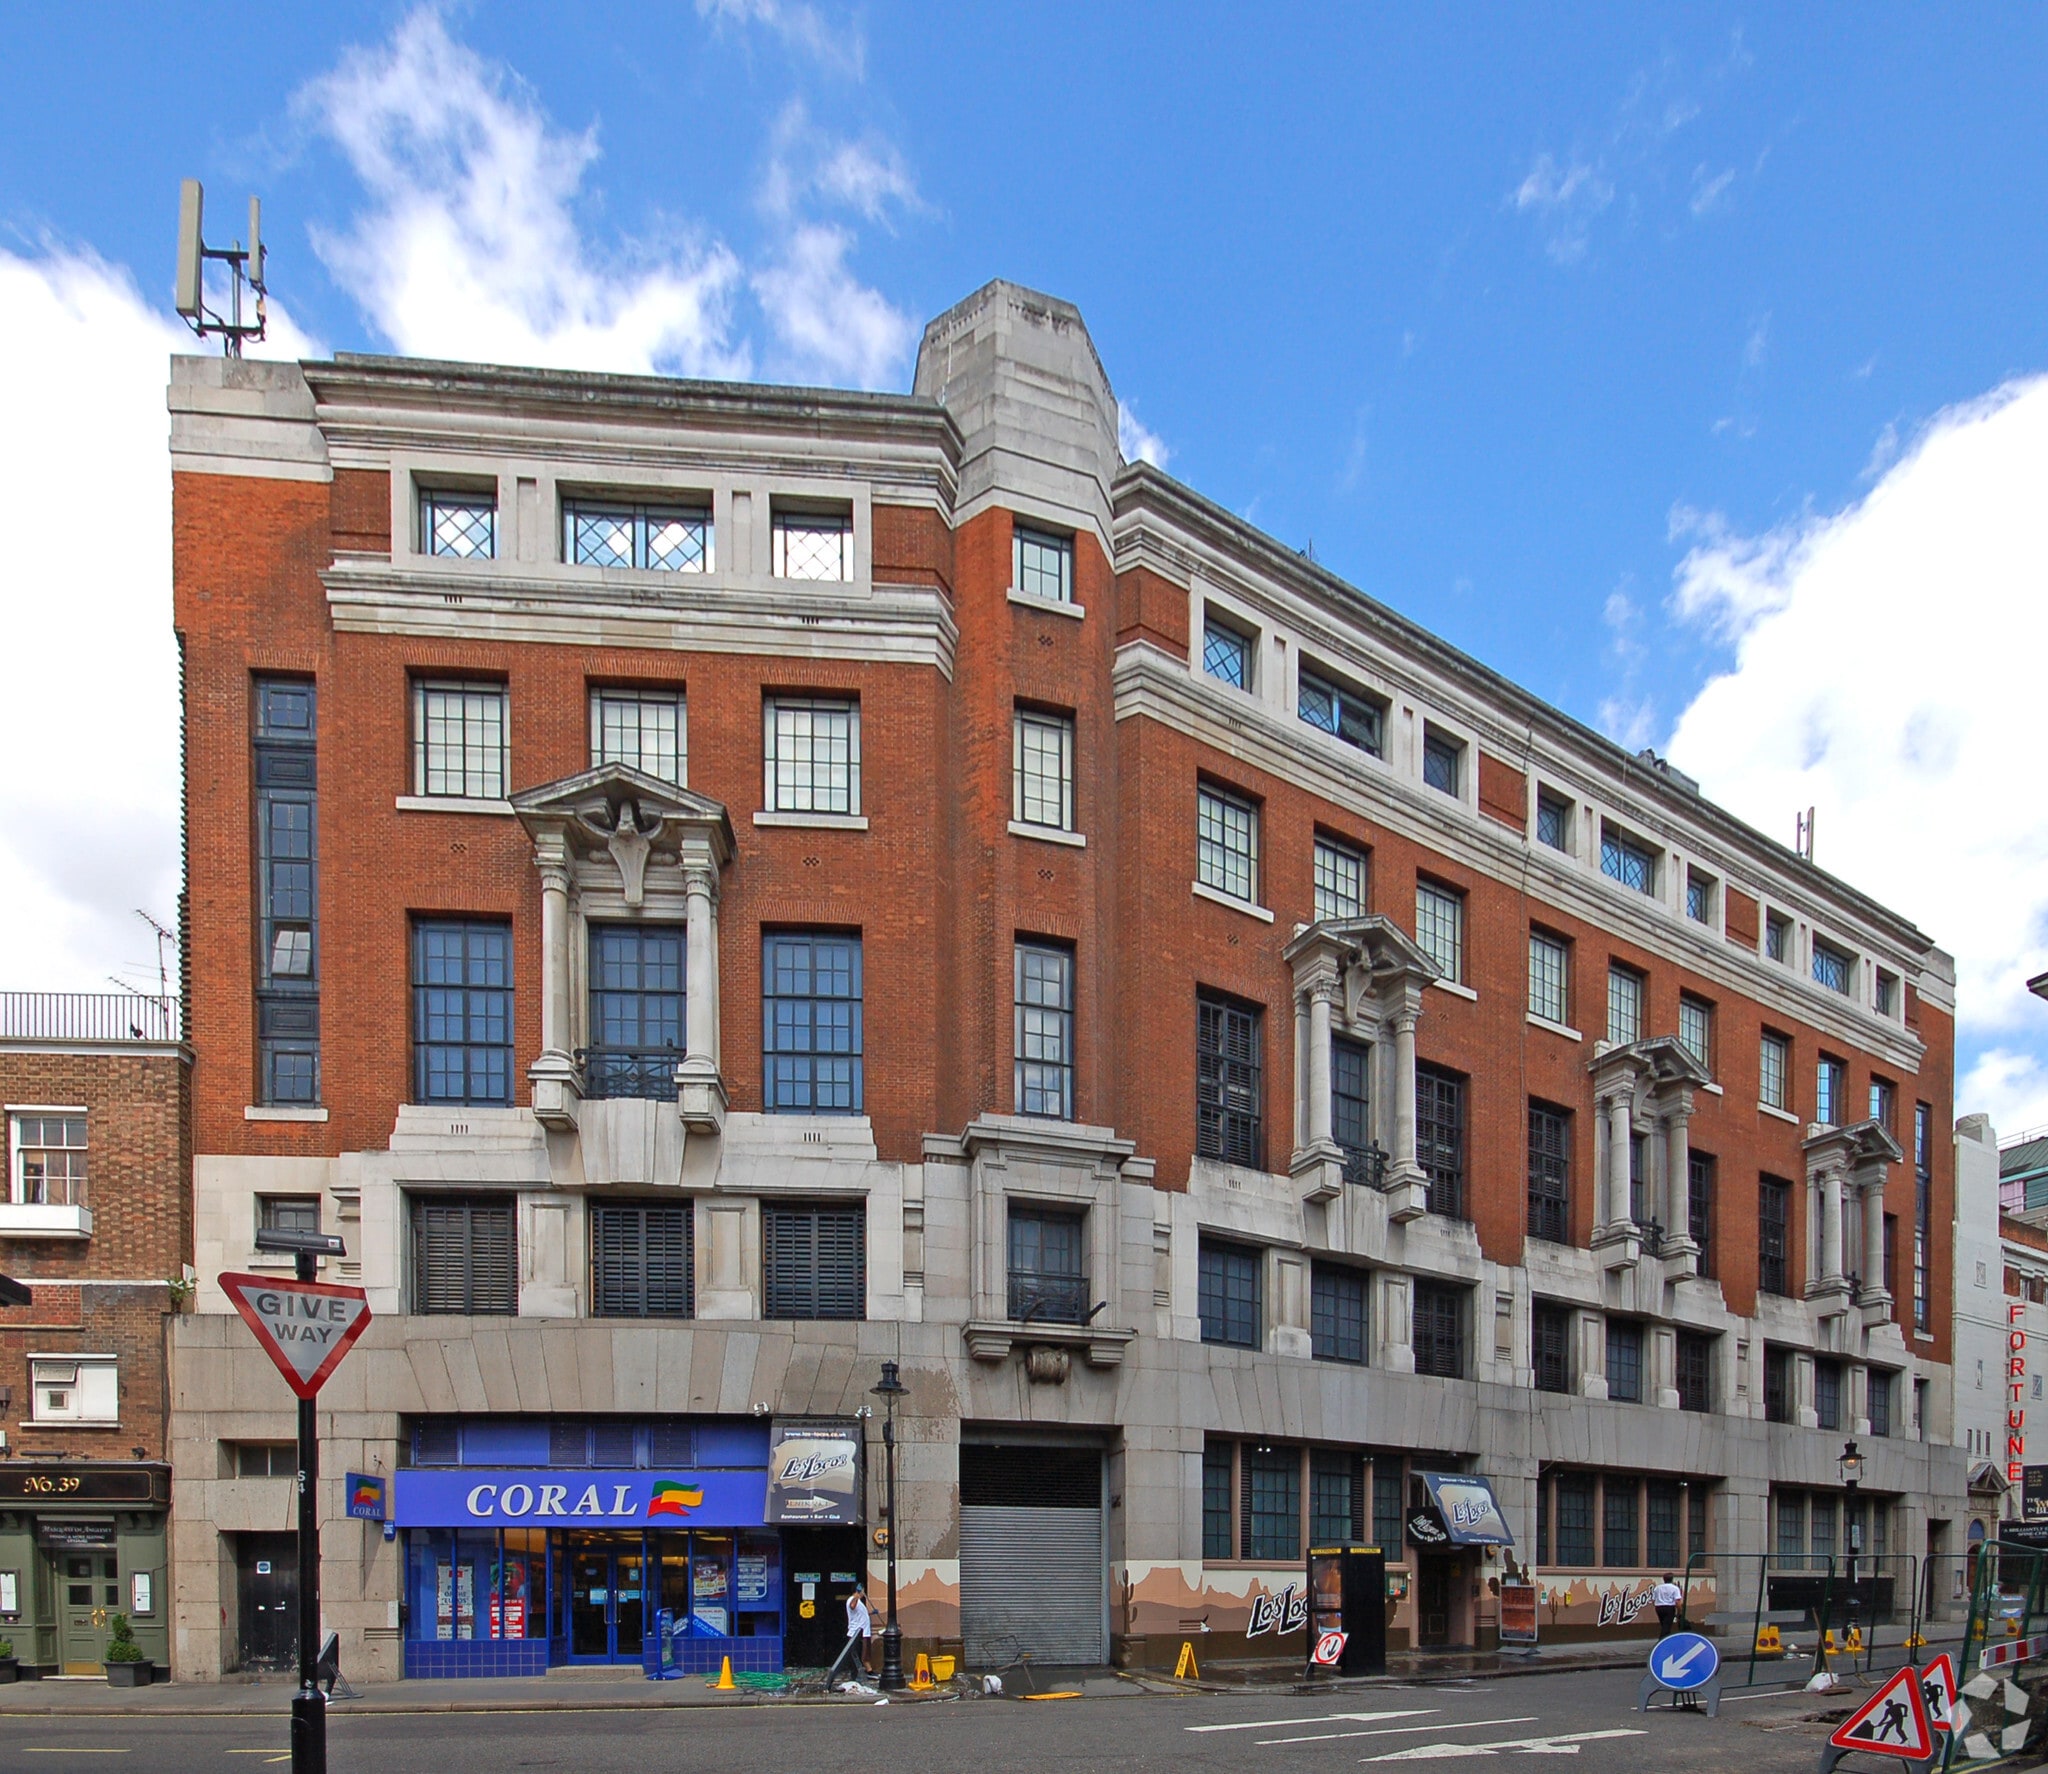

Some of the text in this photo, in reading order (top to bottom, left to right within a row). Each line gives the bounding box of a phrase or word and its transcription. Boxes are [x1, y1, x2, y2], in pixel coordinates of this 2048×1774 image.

[256, 1293, 347, 1322] GIVE
[274, 1323, 332, 1343] WAY
[2008, 1304, 2026, 1481] FORTUNE
[24, 1476, 80, 1493] No. 39
[352, 1506, 382, 1517] CORAL
[466, 1483, 638, 1518] CORAL
